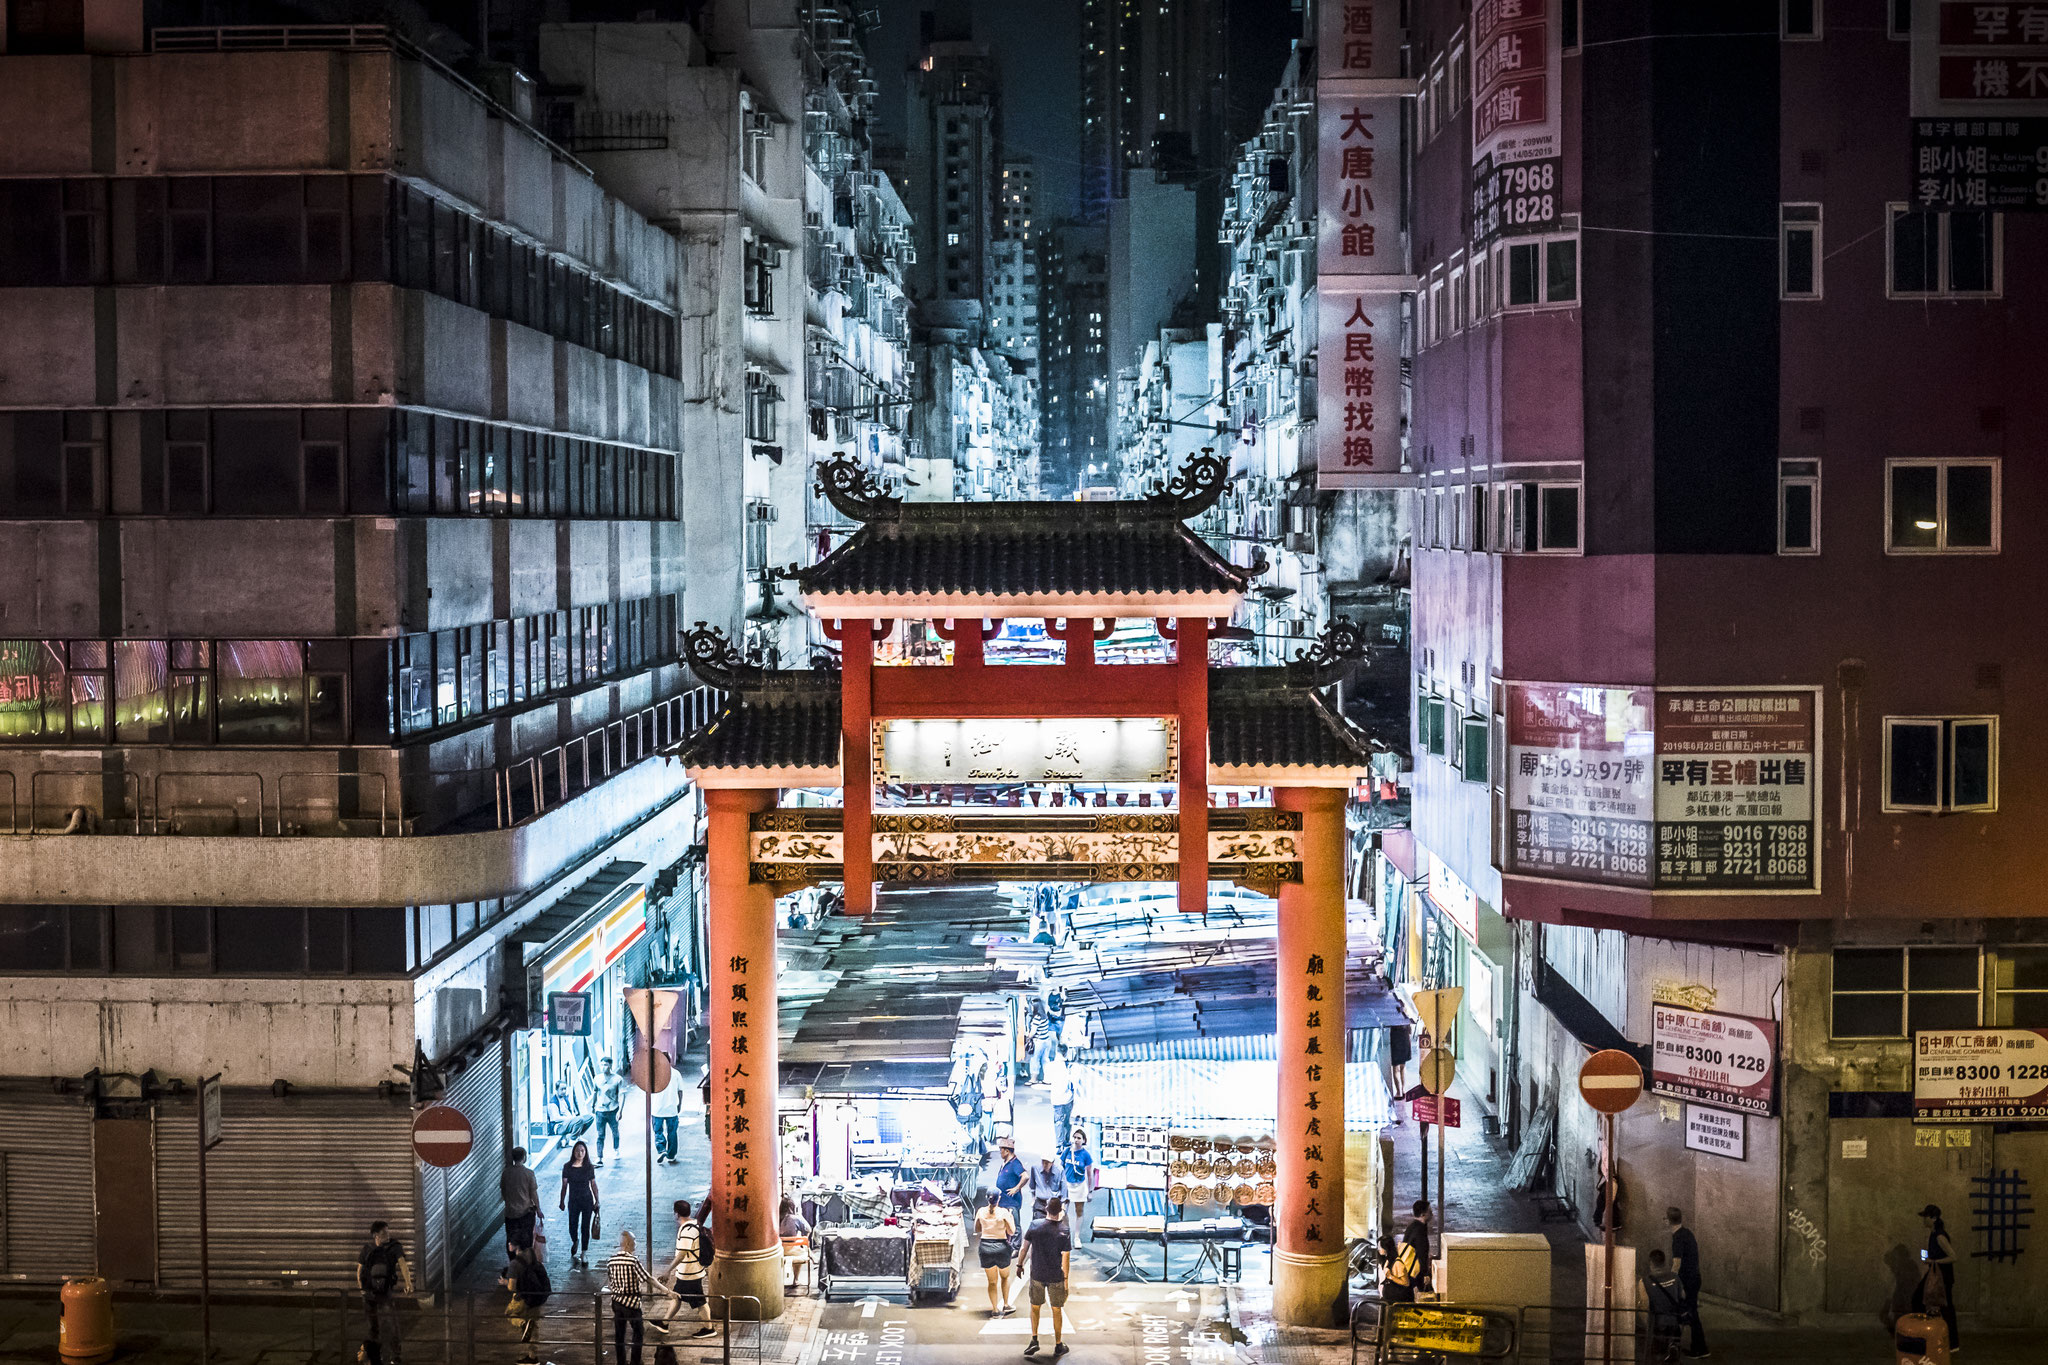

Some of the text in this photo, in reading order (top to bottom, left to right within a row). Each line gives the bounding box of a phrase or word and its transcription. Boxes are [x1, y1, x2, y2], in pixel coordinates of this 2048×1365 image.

[1973, 6, 2048, 43] 罕有
[1972, 60, 2048, 97] 機不
[1919, 145, 1988, 174] 郎小姐
[1340, 106, 1375, 258] 大唐小館
[1502, 163, 1553, 195] 7968
[1918, 178, 1988, 206] 李小姐
[1502, 194, 1553, 225] 1828
[1344, 297, 1374, 467] 人民幣找換
[1662, 759, 1806, 786] 罕有全幢出售
[1571, 818, 1607, 837] 9016
[1611, 823, 1647, 840] 7968
[1661, 825, 1698, 842] 郎小姐
[1723, 825, 1763, 841] 9016
[1768, 825, 1807, 841] 7968
[1571, 835, 1605, 853] 9231
[1612, 839, 1647, 857] 1828
[1661, 843, 1698, 859] 李小姐
[1723, 842, 1761, 858] 9231
[1768, 842, 1807, 858] 1828
[1571, 851, 1605, 870] 2721
[1611, 855, 1647, 874] 8068
[1723, 859, 1761, 875] 2721
[1768, 859, 1807, 875] 8068
[1686, 1046, 1722, 1065] 8300
[1727, 1053, 1765, 1072] 1228
[1956, 1065, 2000, 1080] 8300
[2007, 1065, 2048, 1080] 1228
[1705, 1091, 1734, 1104] 2810
[1738, 1097, 1767, 1110] 9900
[1981, 1107, 2015, 1116] 2810
[2021, 1107, 2048, 1116] 990
[879, 1320, 908, 1348] LOOK
[1141, 1313, 1169, 1344] RIGHT
[822, 1331, 869, 1362] 望左
